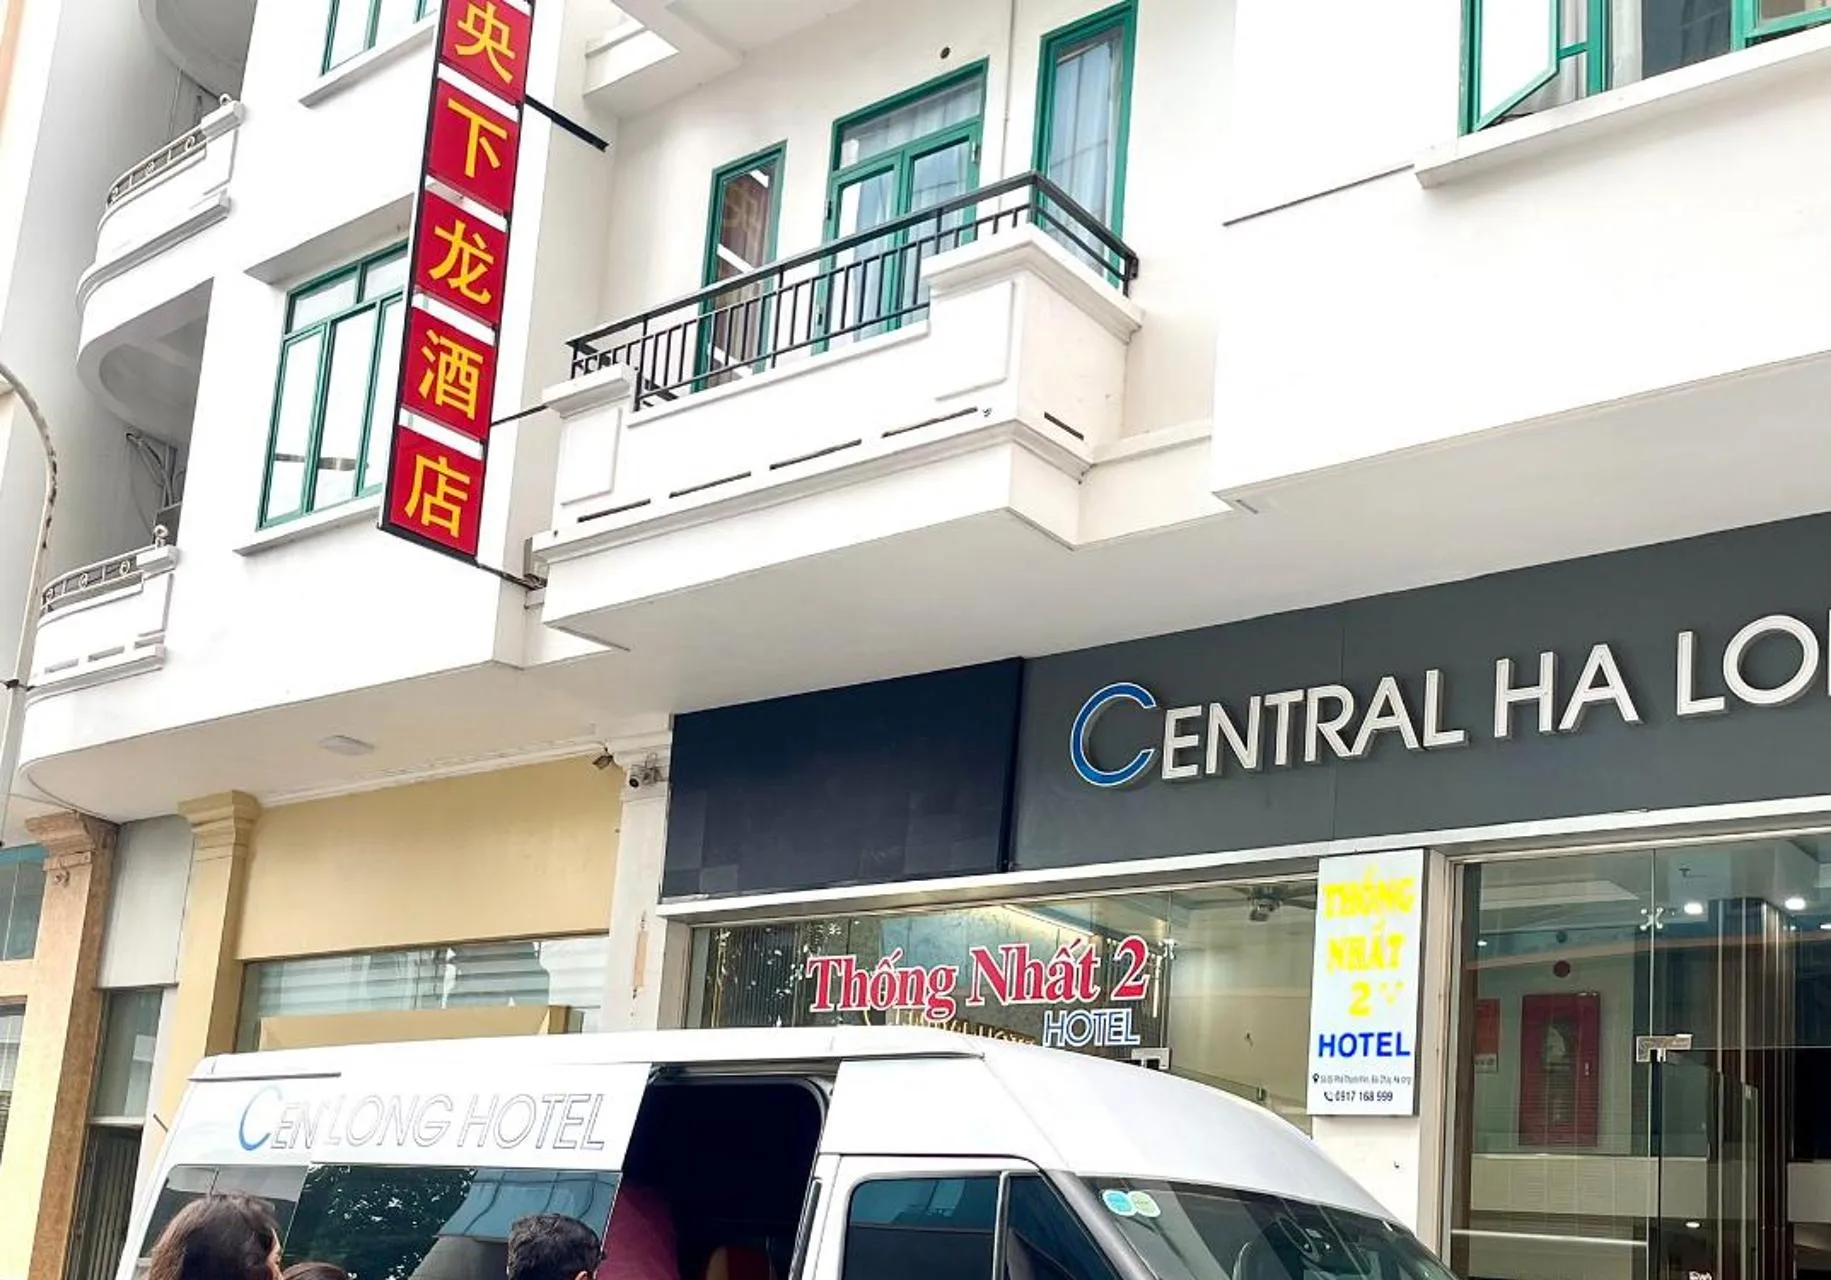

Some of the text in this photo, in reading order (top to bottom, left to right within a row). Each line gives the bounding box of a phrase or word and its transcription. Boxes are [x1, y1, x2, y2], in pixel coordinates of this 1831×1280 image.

[403, 1, 516, 538] 央下龙酒店
[1069, 610, 1831, 787] CENTRAL HA LO
[805, 934, 1153, 1022] Thống Nhất 2
[1348, 981, 1373, 1017] 2
[1042, 1008, 1141, 1048] HOTEL
[1318, 1031, 1411, 1058] HOTEL
[457, 1093, 607, 1151] HOTEL
